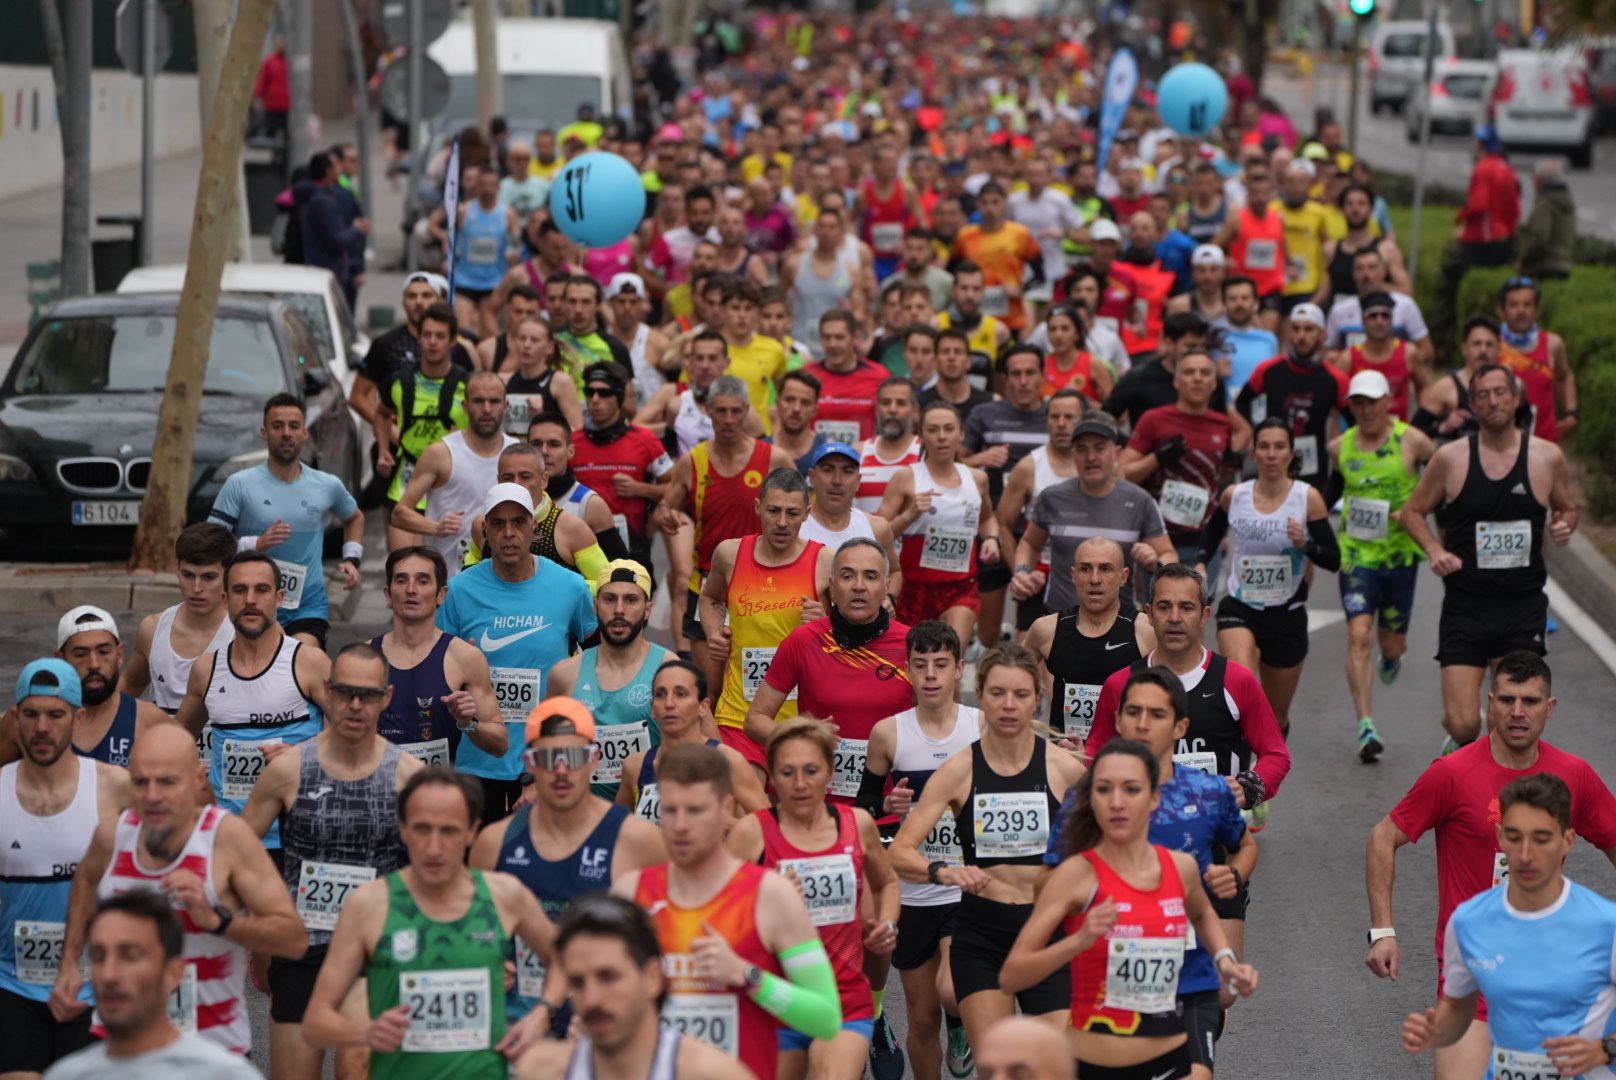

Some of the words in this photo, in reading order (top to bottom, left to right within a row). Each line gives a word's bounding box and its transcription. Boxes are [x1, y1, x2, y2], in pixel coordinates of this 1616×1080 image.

[84, 503, 129, 521] 6104
[1350, 507, 1381, 526] 2321
[928, 536, 967, 555] 2579
[1482, 533, 1525, 550] 2382
[1246, 568, 1285, 584] 2374
[493, 615, 543, 629] HICHAM
[491, 682, 532, 702] 596
[1070, 699, 1098, 719] 23
[110, 736, 129, 755] LF
[227, 755, 268, 776] 222
[982, 809, 1039, 833] 2393
[1003, 832, 1020, 842] DIO
[581, 846, 608, 867] LF
[924, 845, 951, 854] WHITE
[305, 879, 360, 905] 237
[1115, 958, 1176, 983] 4073
[410, 990, 478, 1020] 2418
